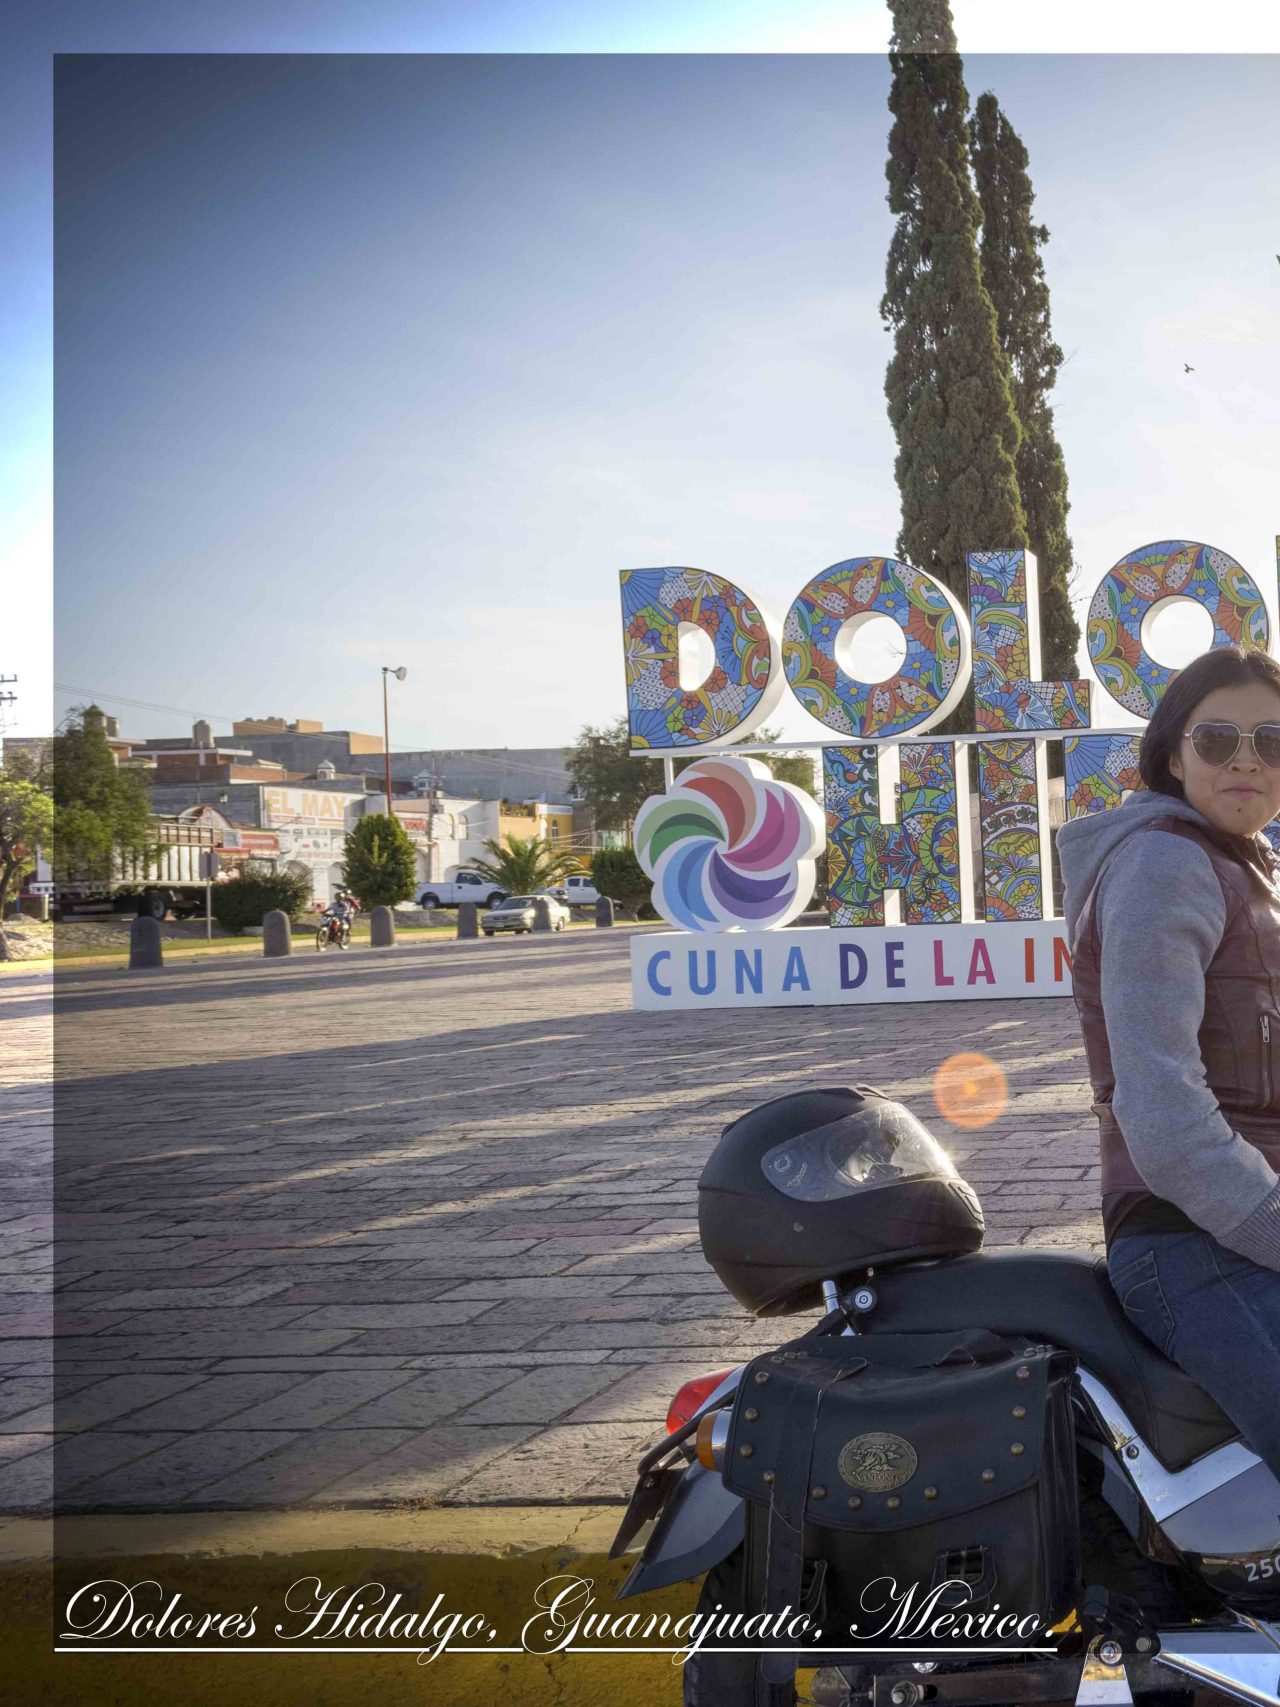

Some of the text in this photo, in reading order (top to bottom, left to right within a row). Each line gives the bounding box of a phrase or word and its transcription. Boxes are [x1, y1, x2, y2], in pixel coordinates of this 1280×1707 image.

[268, 789, 295, 814] EL
[647, 946, 810, 995] CUNA
[839, 942, 906, 990] DE
[933, 938, 997, 985] LA
